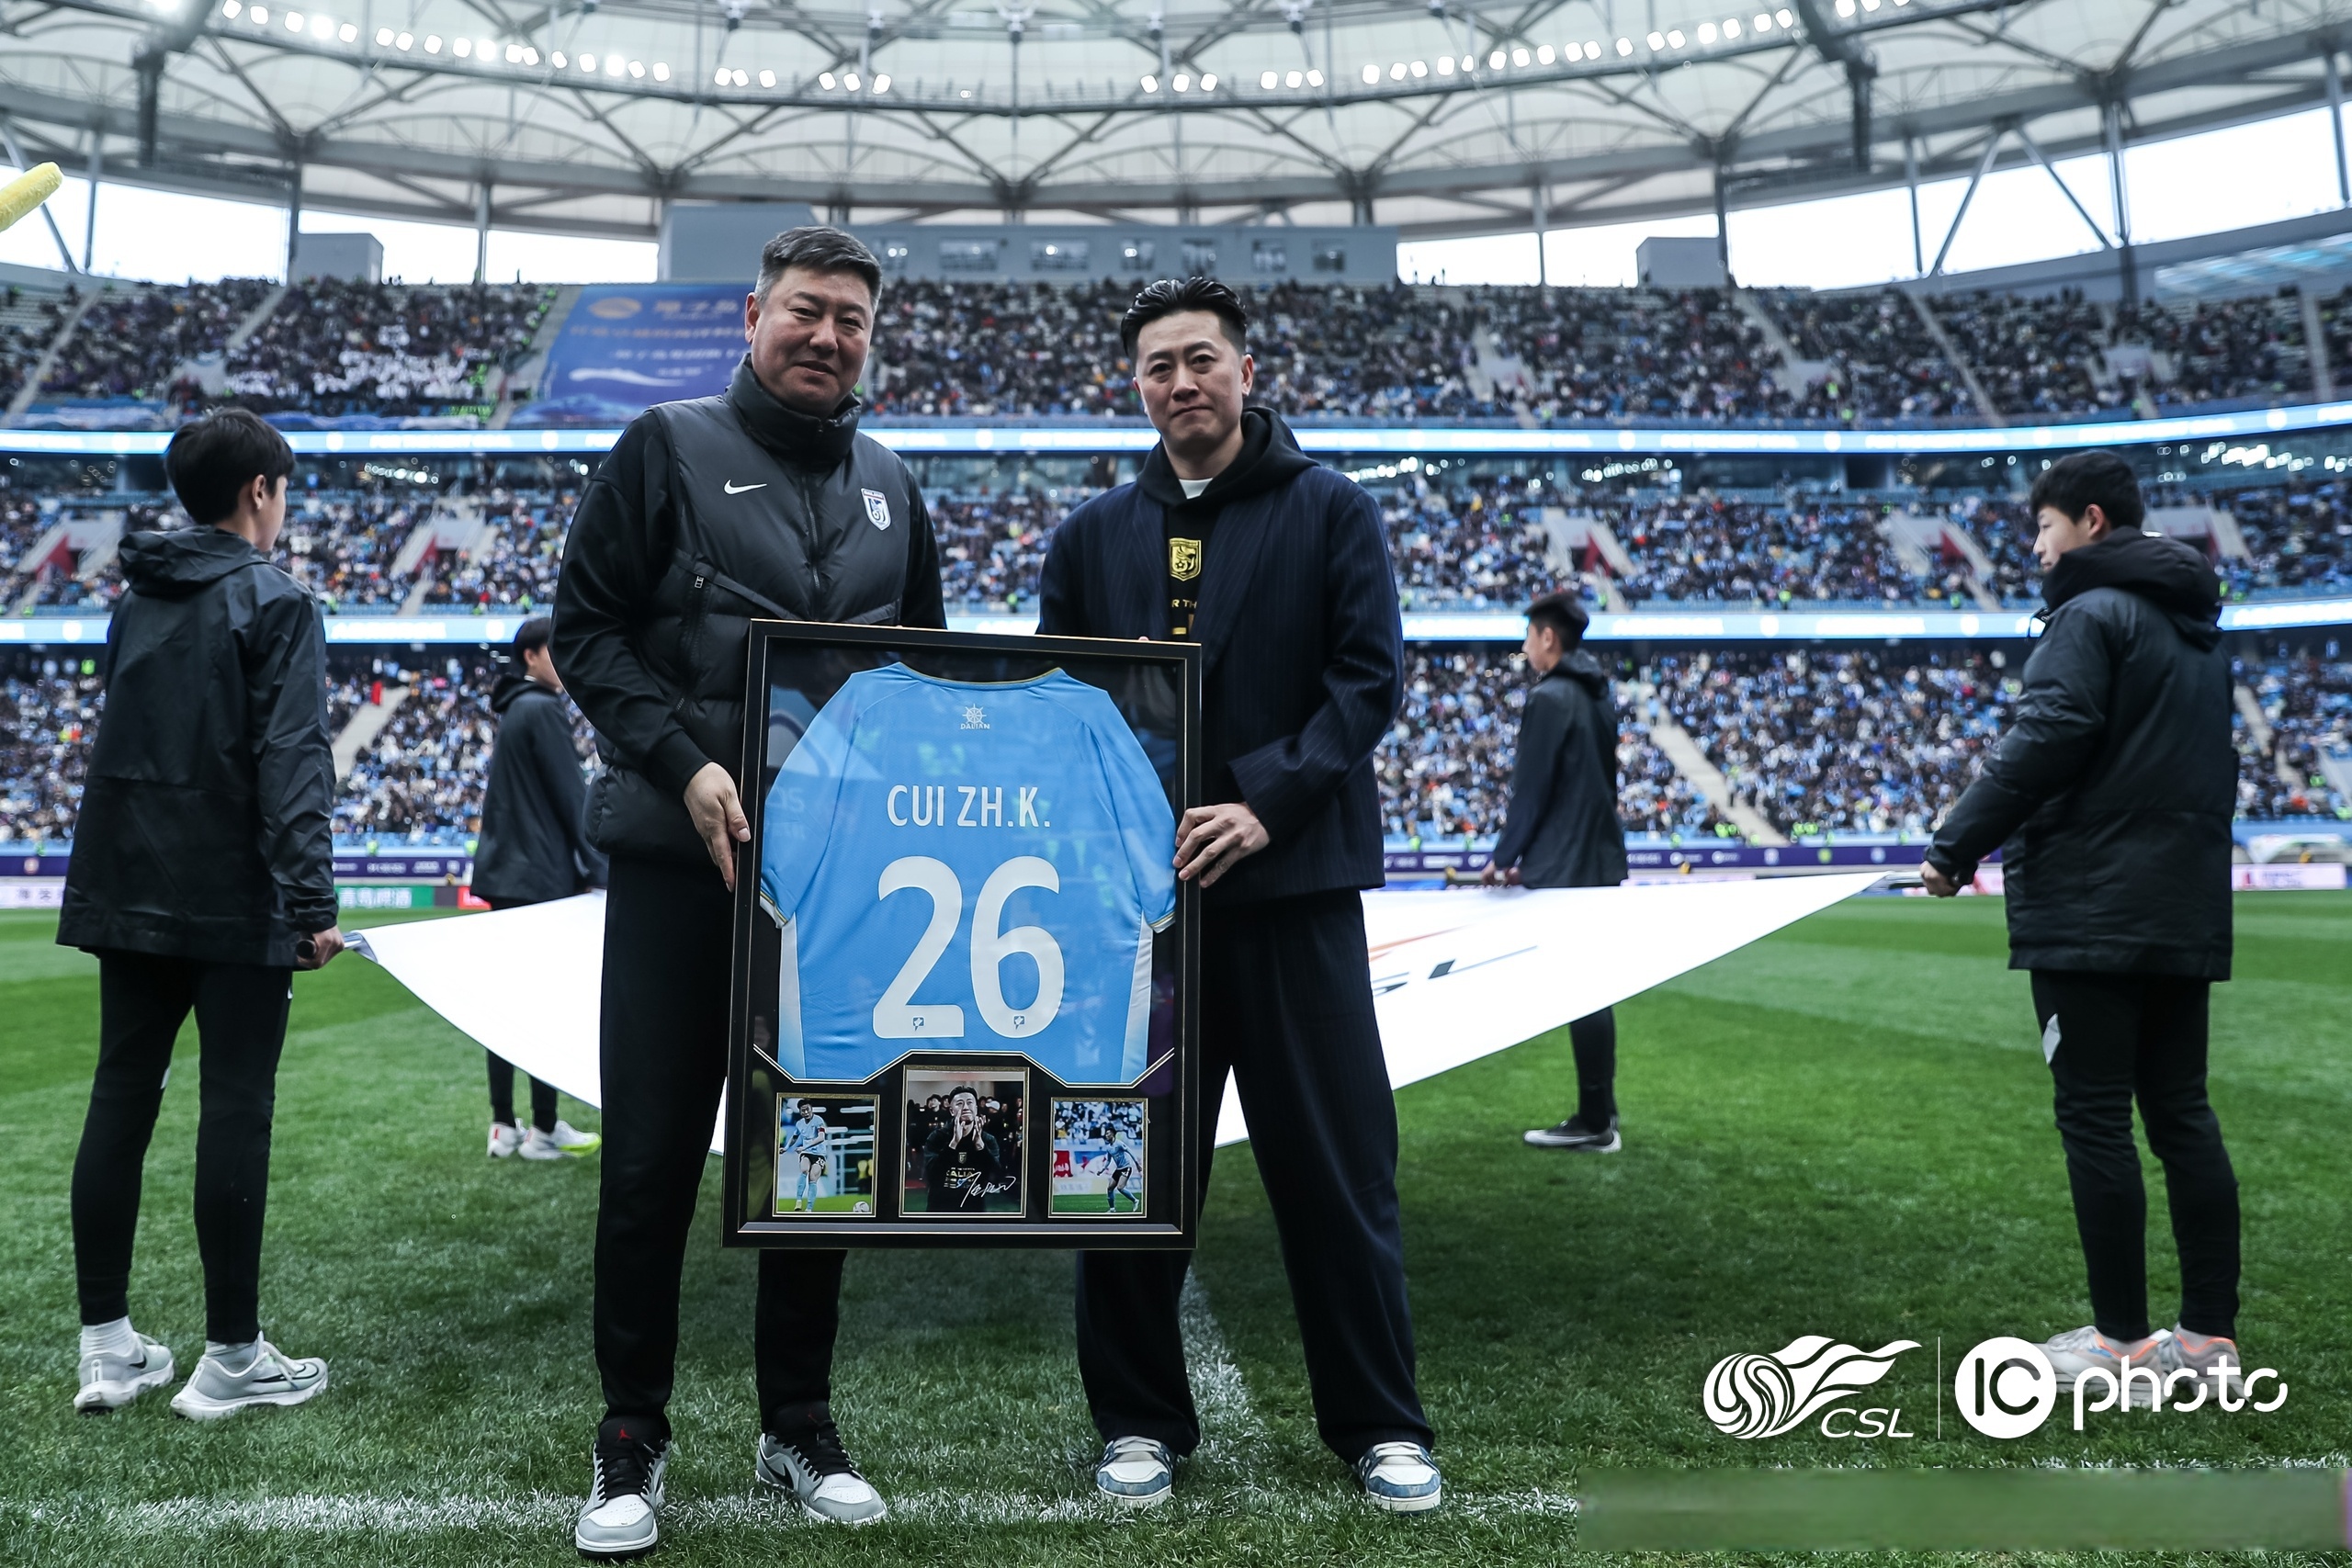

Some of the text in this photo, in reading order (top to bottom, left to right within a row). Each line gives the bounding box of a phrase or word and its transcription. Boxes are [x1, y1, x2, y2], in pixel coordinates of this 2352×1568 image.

[887, 784, 1051, 828] CUI ZH.K.
[872, 855, 1066, 1039] 26
